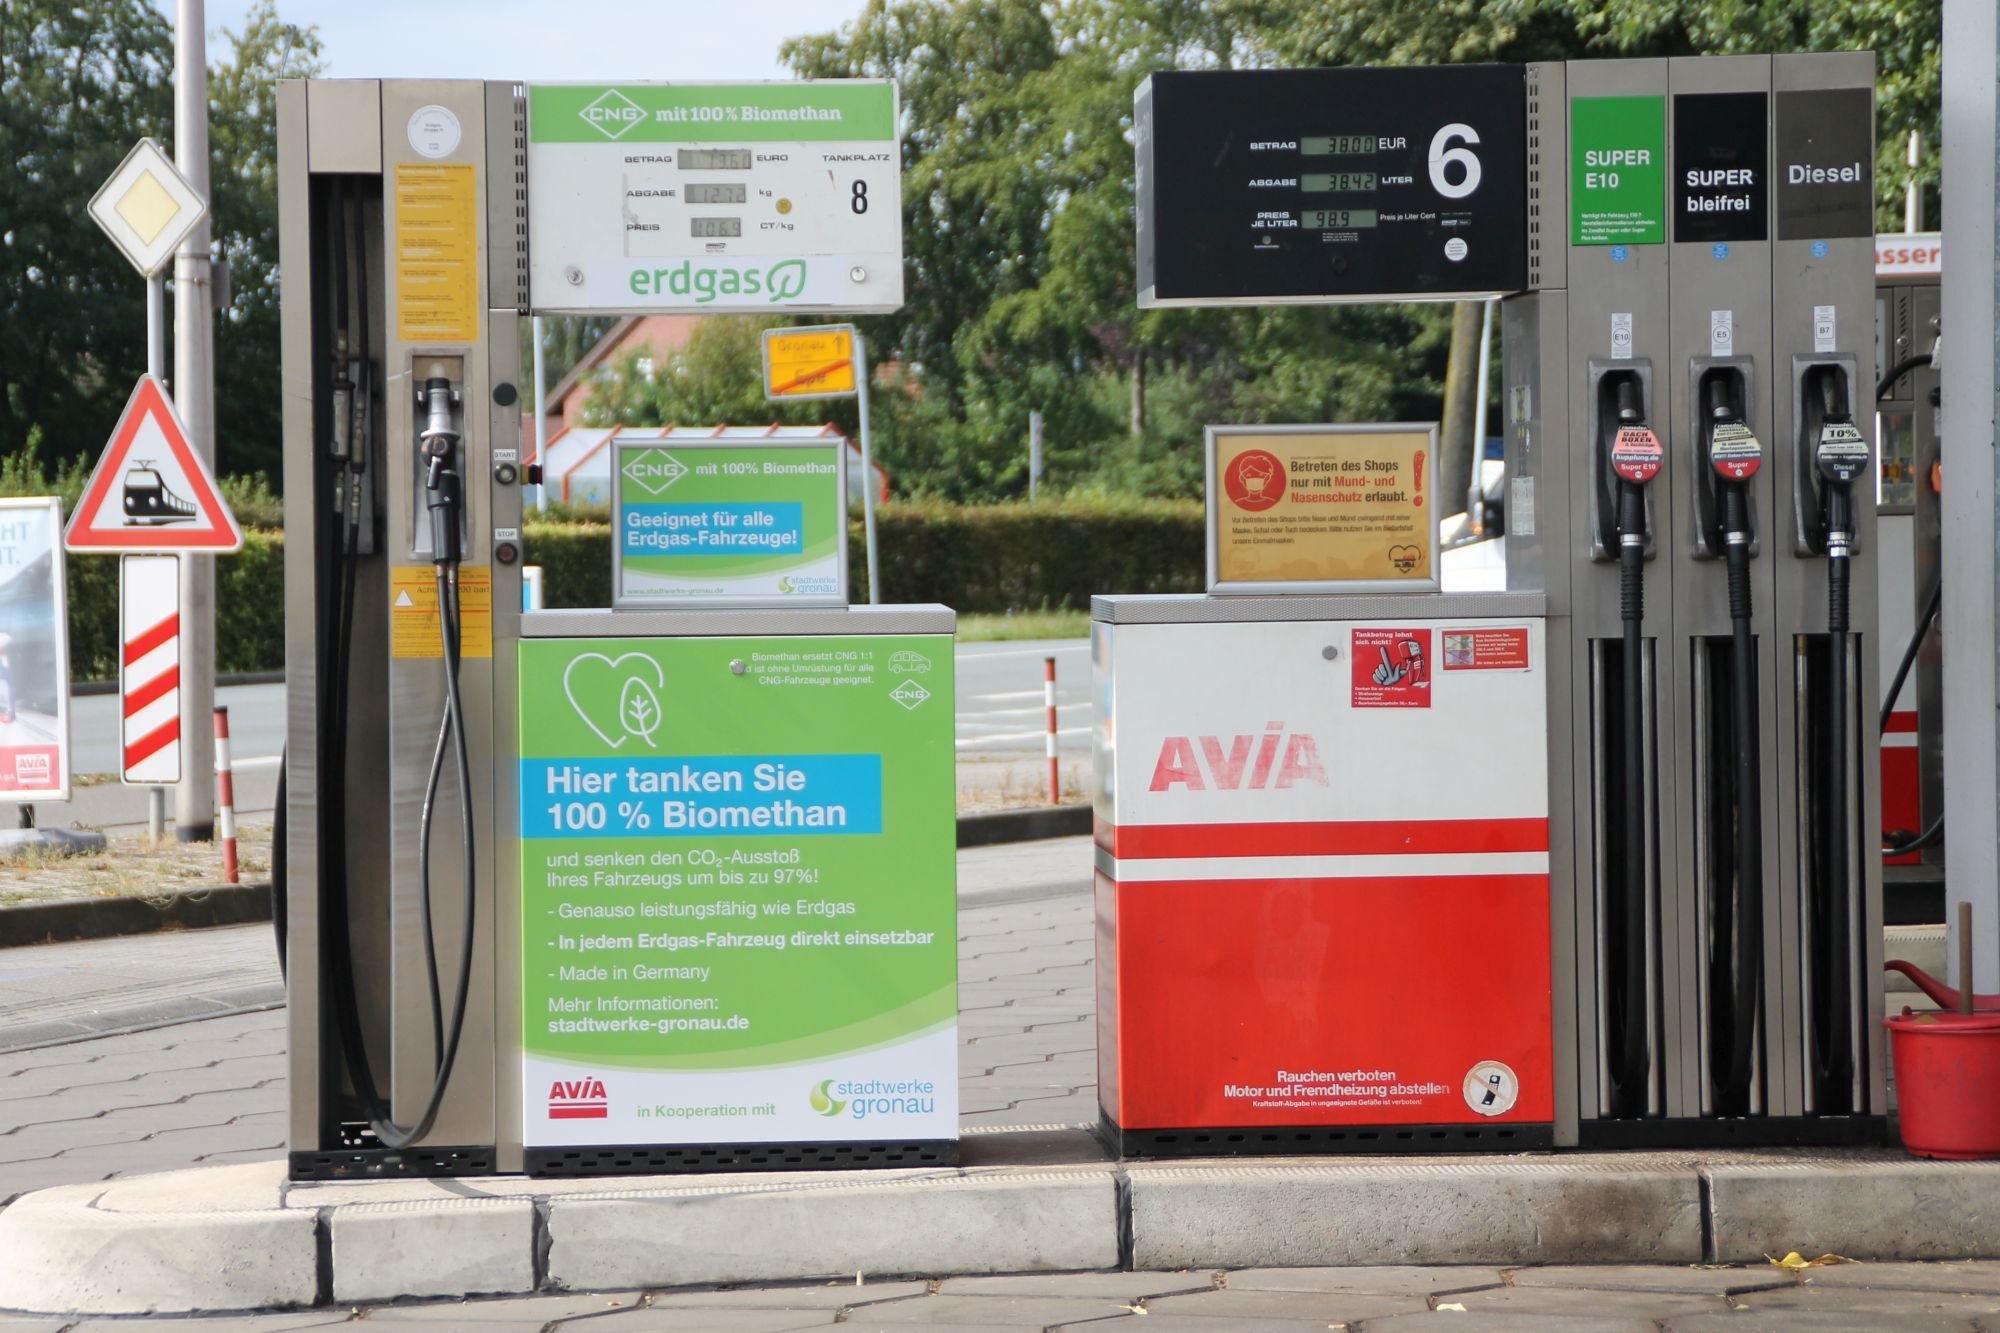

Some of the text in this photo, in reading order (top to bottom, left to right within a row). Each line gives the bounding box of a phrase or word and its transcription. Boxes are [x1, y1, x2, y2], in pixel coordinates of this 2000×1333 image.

[588, 107, 638, 121] CNG
[656, 105, 689, 122] mit
[741, 104, 841, 122] Biomethan
[1250, 141, 1297, 151] BETRAG
[1328, 137, 1374, 153] 38.00
[1379, 136, 1406, 150] EUR
[624, 155, 672, 163] BETRAG
[757, 154, 788, 162] EURO
[821, 154, 890, 162] TANKPLATZ
[1428, 123, 1482, 199] 6
[1585, 149, 1650, 167] SUPER
[1382, 175, 1413, 184] LITER
[1585, 172, 1619, 188] E10
[1686, 168, 1754, 187] SUPER
[1788, 162, 1861, 184] Diesel
[1249, 178, 1297, 187] ABGABE
[1328, 174, 1375, 191] 38.42
[626, 189, 676, 197] ABGABE
[759, 189, 772, 198] kg
[851, 179, 868, 214] 8
[1687, 194, 1750, 211] bleifrei
[1257, 212, 1290, 220] PREIS
[1316, 210, 1350, 228] 98.9
[1380, 213, 1396, 221] Preis
[1397, 213, 1404, 222] je
[1405, 212, 1419, 220] Liter
[1420, 212, 1436, 220] Cent
[1251, 219, 1298, 228] JE LITER
[630, 260, 761, 302] erdgas
[1819, 326, 1830, 334] B7
[1829, 429, 1857, 438] 10%
[631, 463, 679, 476] CNG
[695, 462, 836, 475] mit 100% Biomethan
[1291, 459, 1399, 473] Betreten des Shops
[1621, 463, 1642, 471] Super
[1291, 475, 1395, 488] nur mit Mund- und
[1291, 491, 1408, 503] Nasenschutz erlaubt.
[627, 511, 774, 530] Geeignet für alle
[627, 529, 797, 548] Erdgas-Fahrzeuge!
[797, 584, 837, 595] gronau
[1355, 631, 1394, 639] Tankbetrug
[752, 651, 873, 661] Biomethan ersetzt CNG 1:1
[754, 664, 765, 672] ist
[767, 664, 790, 673] ohne
[792, 663, 842, 675] Umrüstung
[844, 663, 857, 672] für
[858, 663, 874, 672] alle
[758, 675, 874, 686] CNG-Fahrzeuge geeignet.
[895, 690, 925, 699] CNG
[546, 763, 807, 794] Hier tanken Sie
[547, 799, 847, 830] 100 % Biomethan
[546, 850, 579, 868] und
[583, 850, 645, 867] senken
[650, 849, 682, 866] den
[547, 868, 819, 890] Ihres Fahrzeugs um bis zu 97%!
[558, 899, 856, 920] Genauso leistungsfähig wie Erdgas
[559, 929, 934, 952] In jedem Erdgas-Fahrzeug direkt einsetzbar
[559, 963, 710, 983] Made in Germany
[548, 995, 719, 1013] Mehr Informationen:
[548, 1014, 749, 1035] stadtwerke-gronau.de
[1277, 1069, 1396, 1084] Rauchen verboten
[837, 1078, 934, 1096] stadtwerke
[1223, 1081, 1450, 1099] Motor und Fremdheizung abstellen
[851, 1094, 934, 1119] gronau
[1252, 1097, 1423, 1109] Kraftstoff-Abgabe in ungeeignete Gefäße ist verboten!
[637, 1103, 775, 1120] in Kooperation mit
